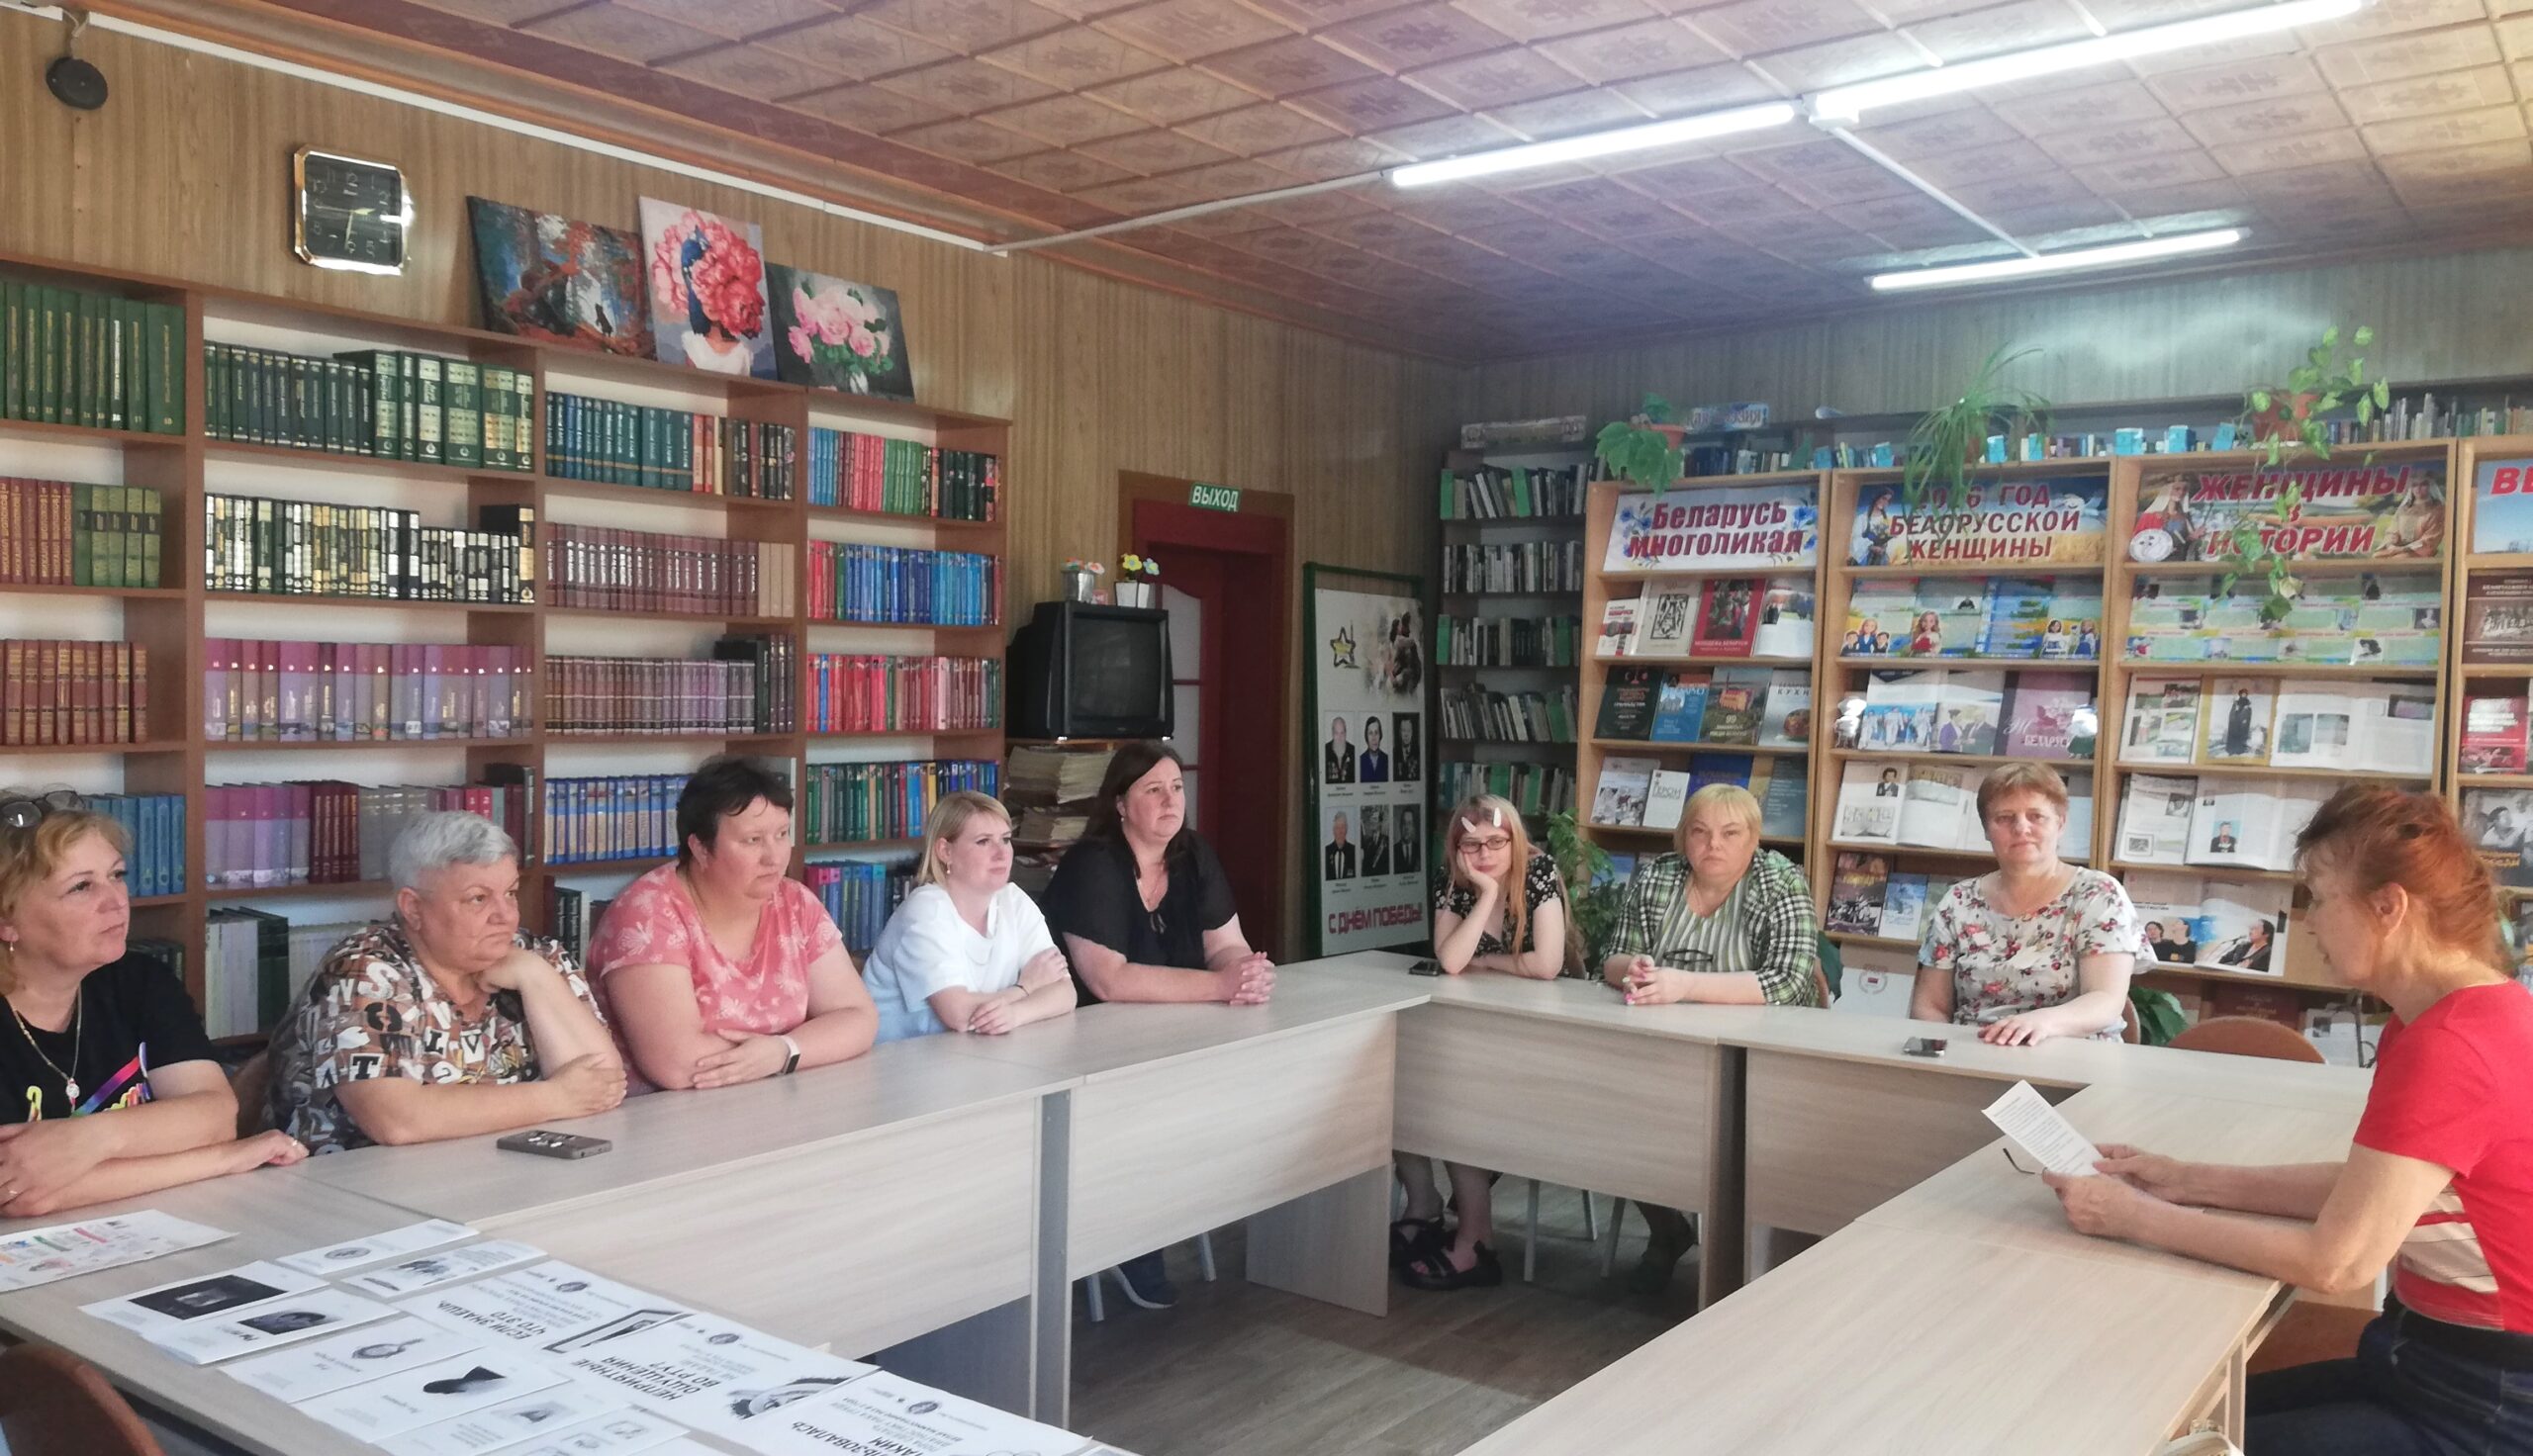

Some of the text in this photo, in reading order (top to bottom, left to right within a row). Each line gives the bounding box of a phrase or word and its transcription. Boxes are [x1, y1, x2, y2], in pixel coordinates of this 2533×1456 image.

[1998, 484, 2051, 508] ГОД
[2191, 466, 2410, 502] ЖЕНЩИНЫ
[1191, 485, 1239, 512] ВЫХОД
[1650, 500, 1787, 530] Беларусь
[1890, 507, 2081, 535] БЕЛОРУССКОЙ
[1626, 529, 1804, 558] многоликая
[1910, 536, 2052, 562] ЖЕНЩИНЫ
[1726, 714, 1737, 724] 99
[1329, 913, 1337, 934] С
[517, 1319, 546, 1335] ЧТО
[571, 1358, 683, 1401] НЕПРИЯТНЫЕ
[601, 1356, 701, 1395] ОЩУЩЕНИЯ
[693, 1376, 720, 1389] ВО
